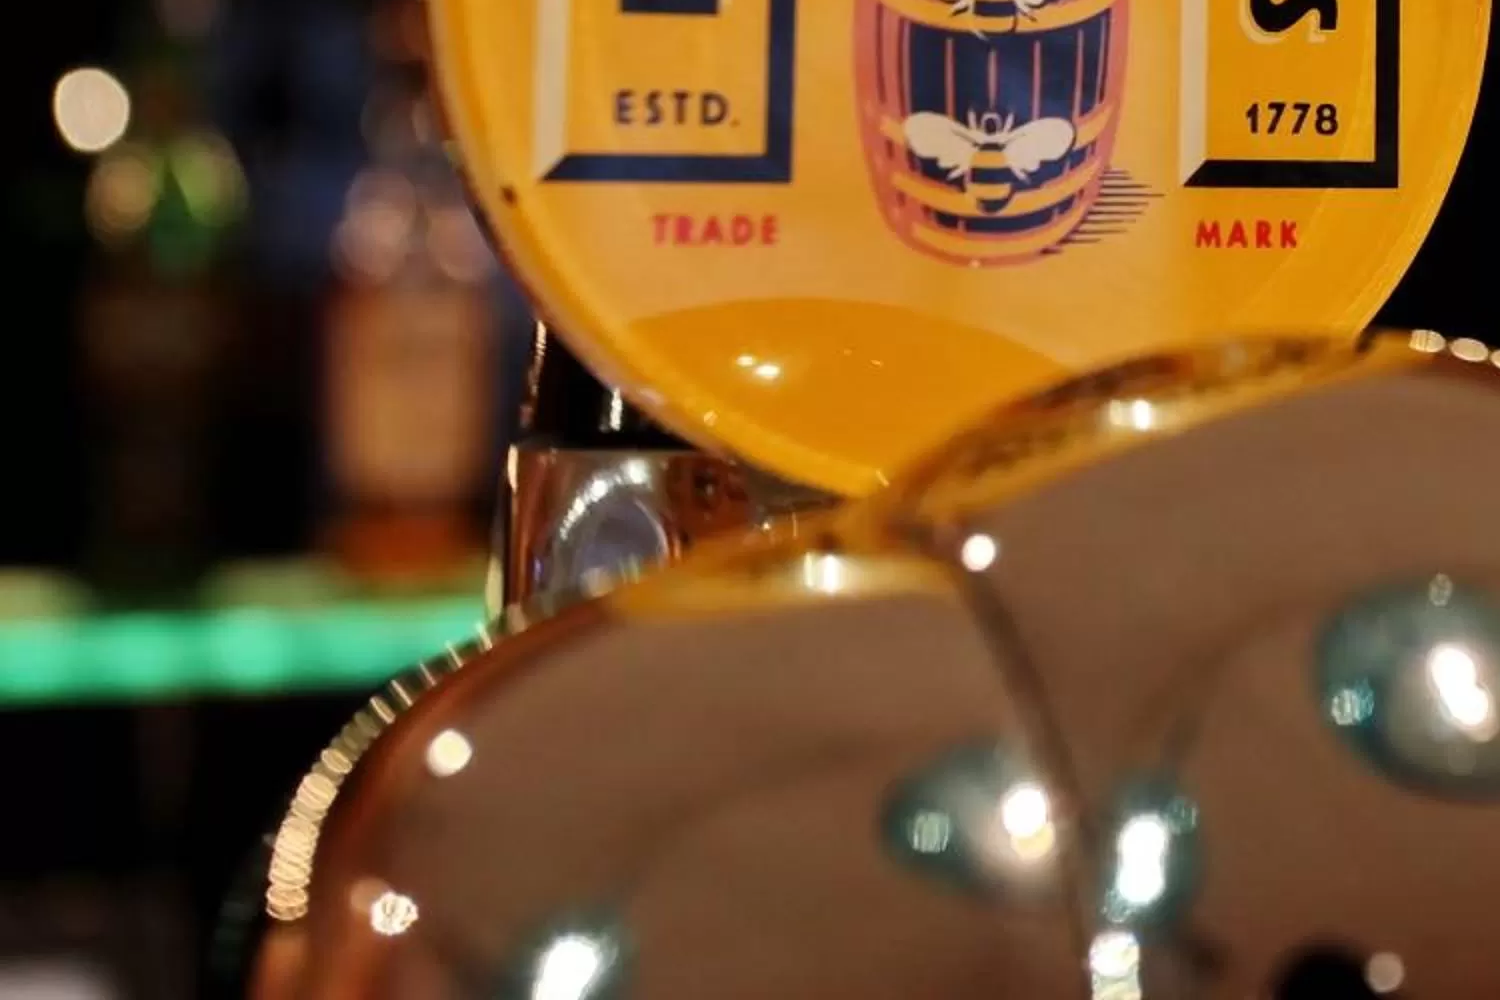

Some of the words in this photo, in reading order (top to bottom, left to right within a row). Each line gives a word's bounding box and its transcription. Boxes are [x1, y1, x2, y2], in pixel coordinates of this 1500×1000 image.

[614, 90, 740, 126] ESTD.
[1245, 102, 1338, 137] 1778
[652, 213, 779, 247] TRADE
[1195, 219, 1298, 250] MARK
